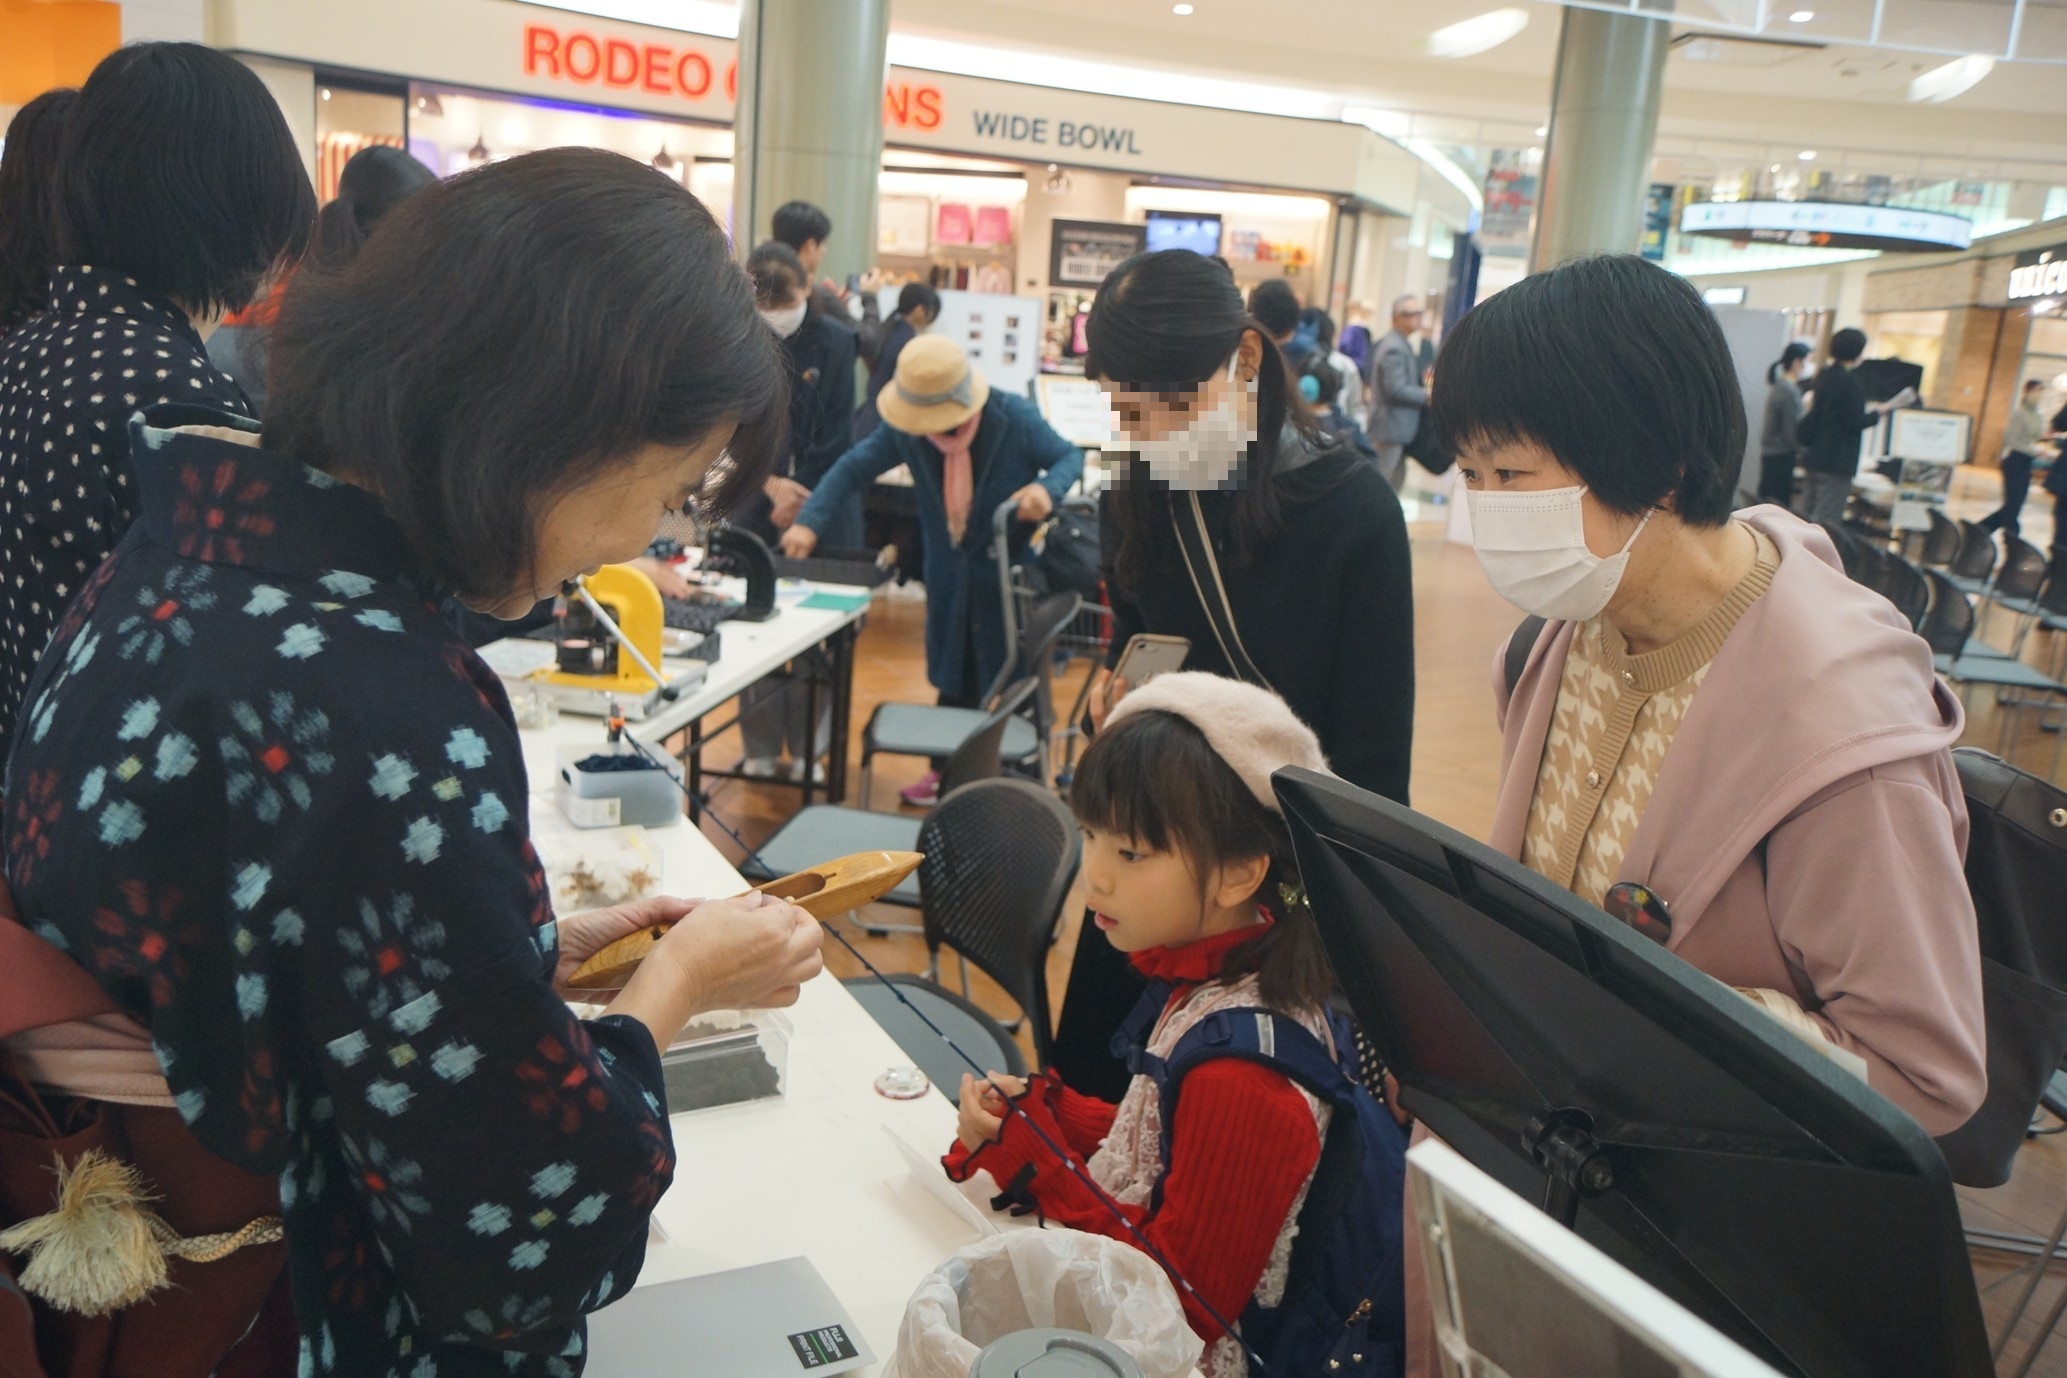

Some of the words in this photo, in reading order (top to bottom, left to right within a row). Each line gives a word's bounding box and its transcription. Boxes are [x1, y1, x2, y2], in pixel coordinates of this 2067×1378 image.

[525, 24, 713, 99] RODEO
[973, 110, 1047, 144] WIDE
[1058, 121, 1142, 155] BOWL
[829, 1327, 844, 1343] FUJI
